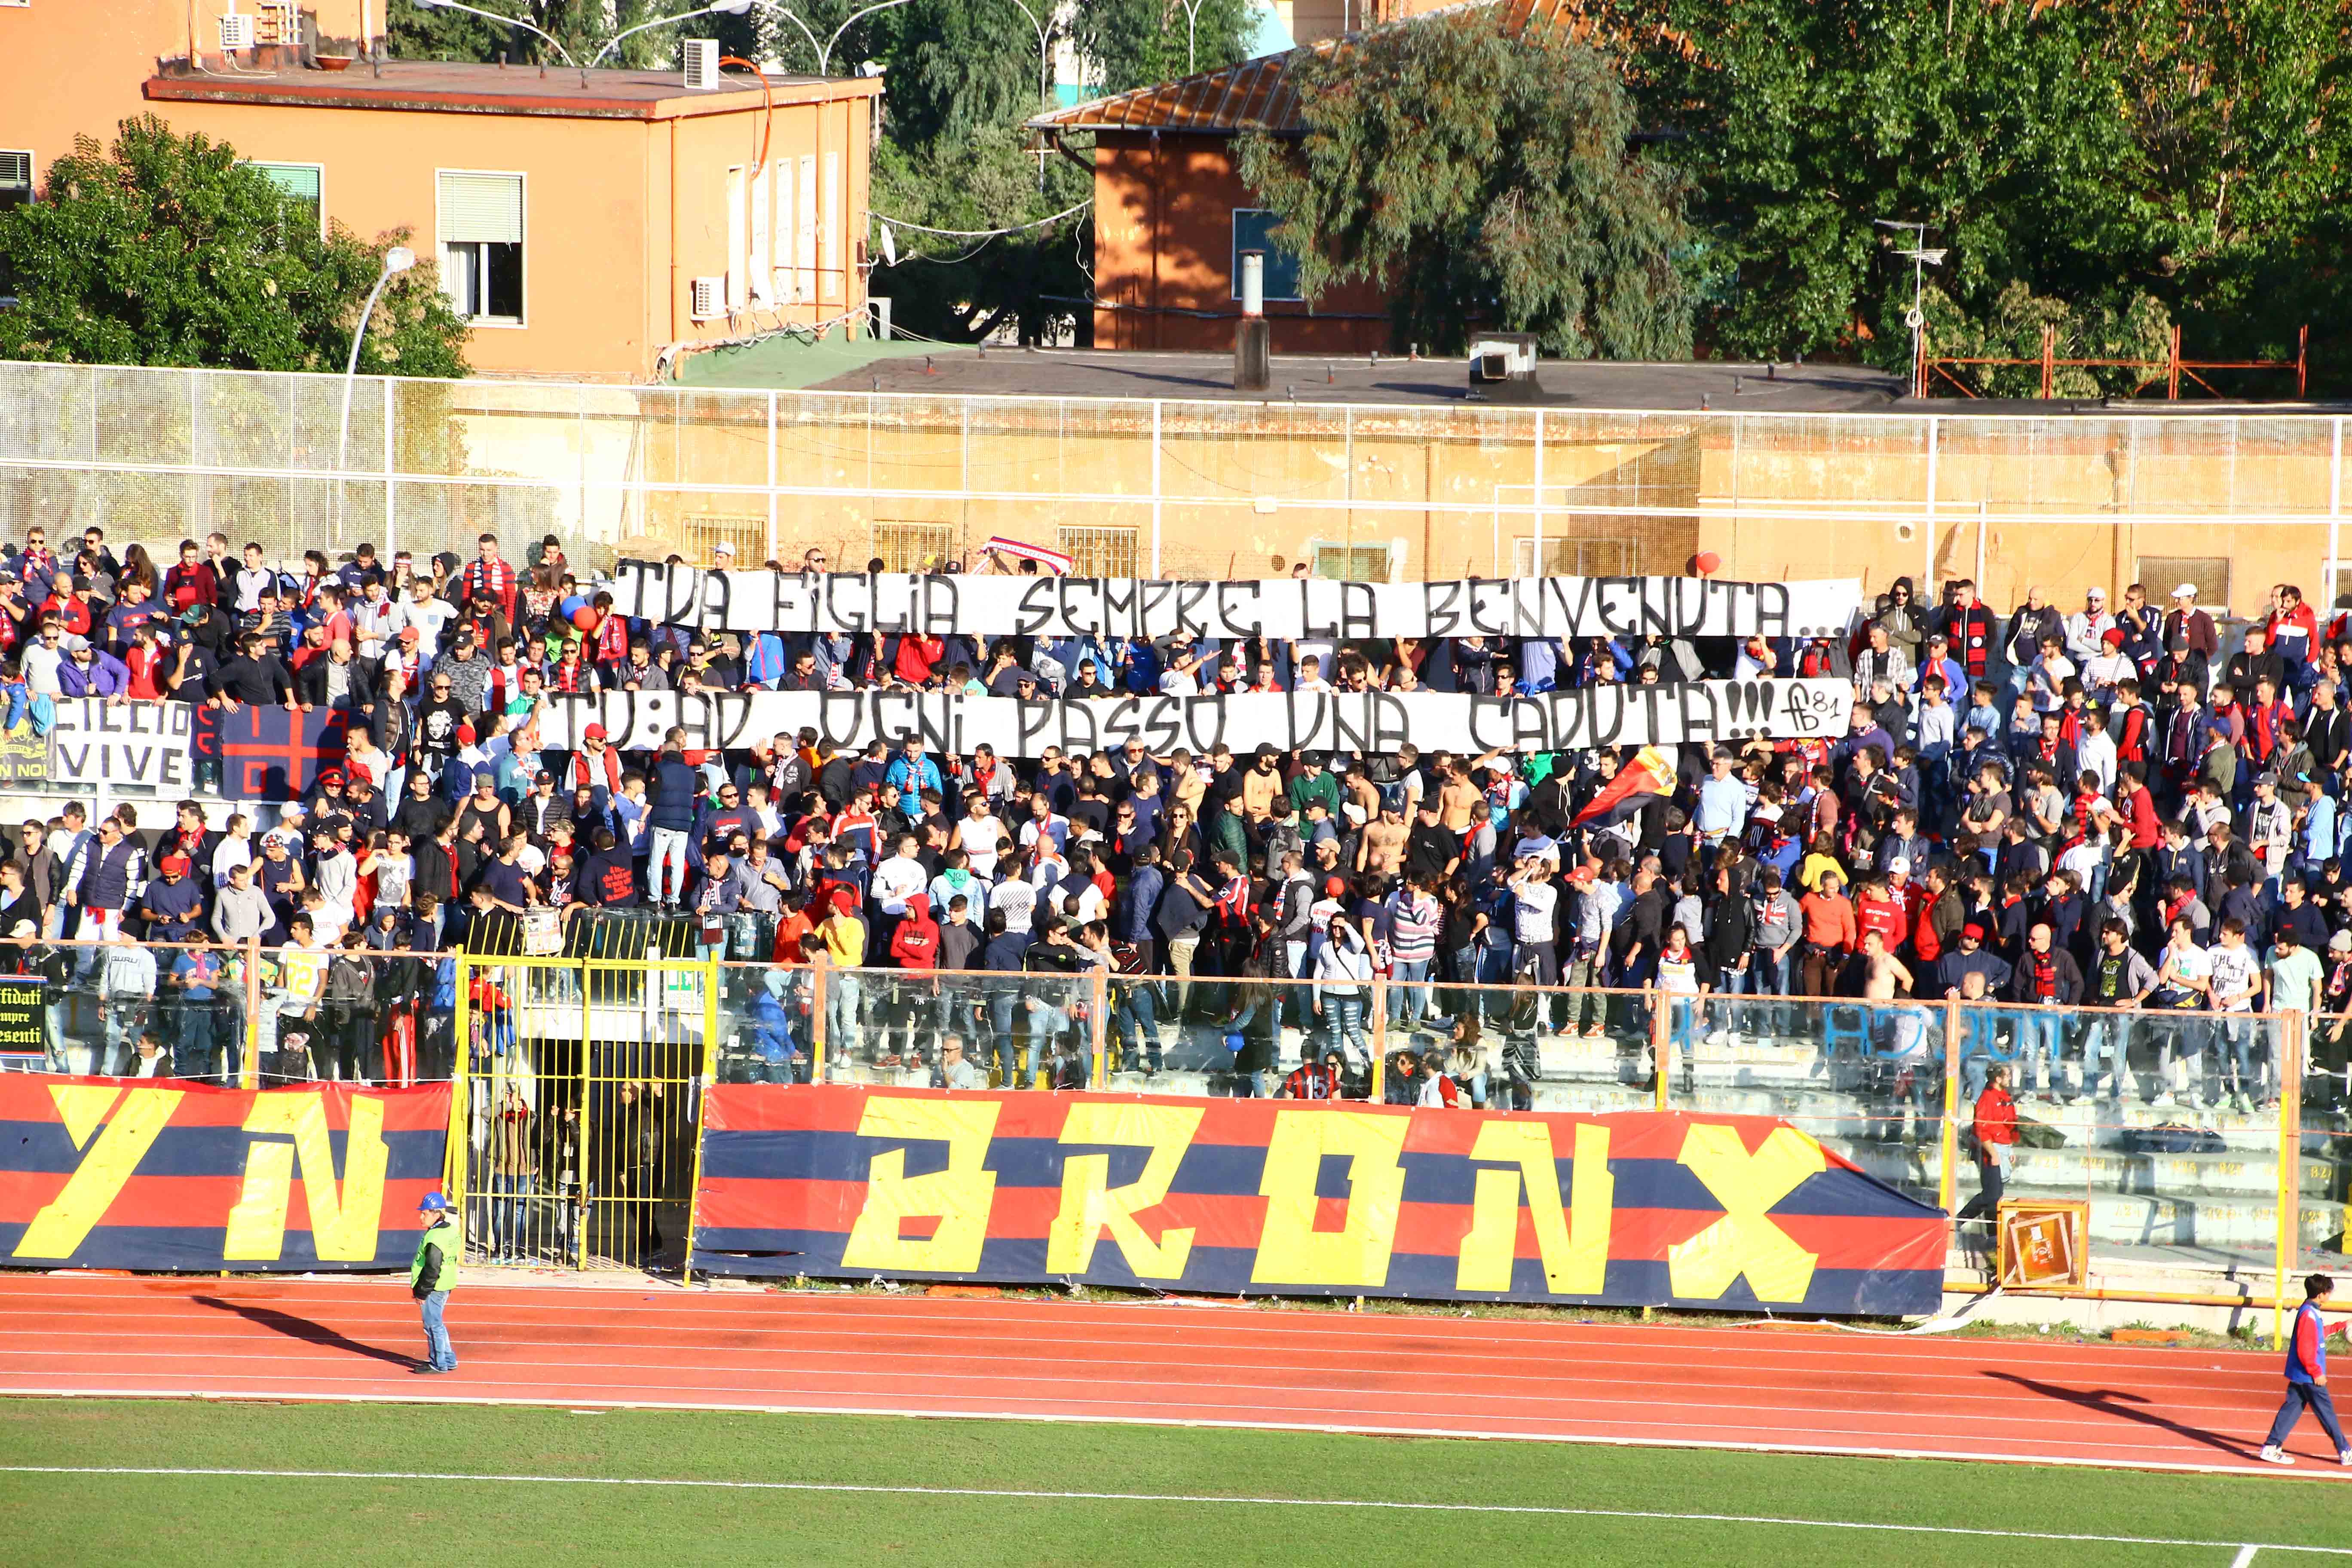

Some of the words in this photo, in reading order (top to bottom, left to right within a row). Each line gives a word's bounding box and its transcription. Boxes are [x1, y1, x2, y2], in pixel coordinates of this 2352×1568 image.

[619, 558, 731, 628] TUA
[1016, 577, 1262, 637] SEMPRE
[1301, 580, 1378, 639] LA
[1017, 696, 1226, 759] PASSO
[1288, 691, 1409, 752] UNA
[17, 764, 47, 777] NOI
[57, 744, 183, 785] VIVE
[1306, 1075, 1328, 1099] 15
[841, 1096, 1826, 1303] BRONX
